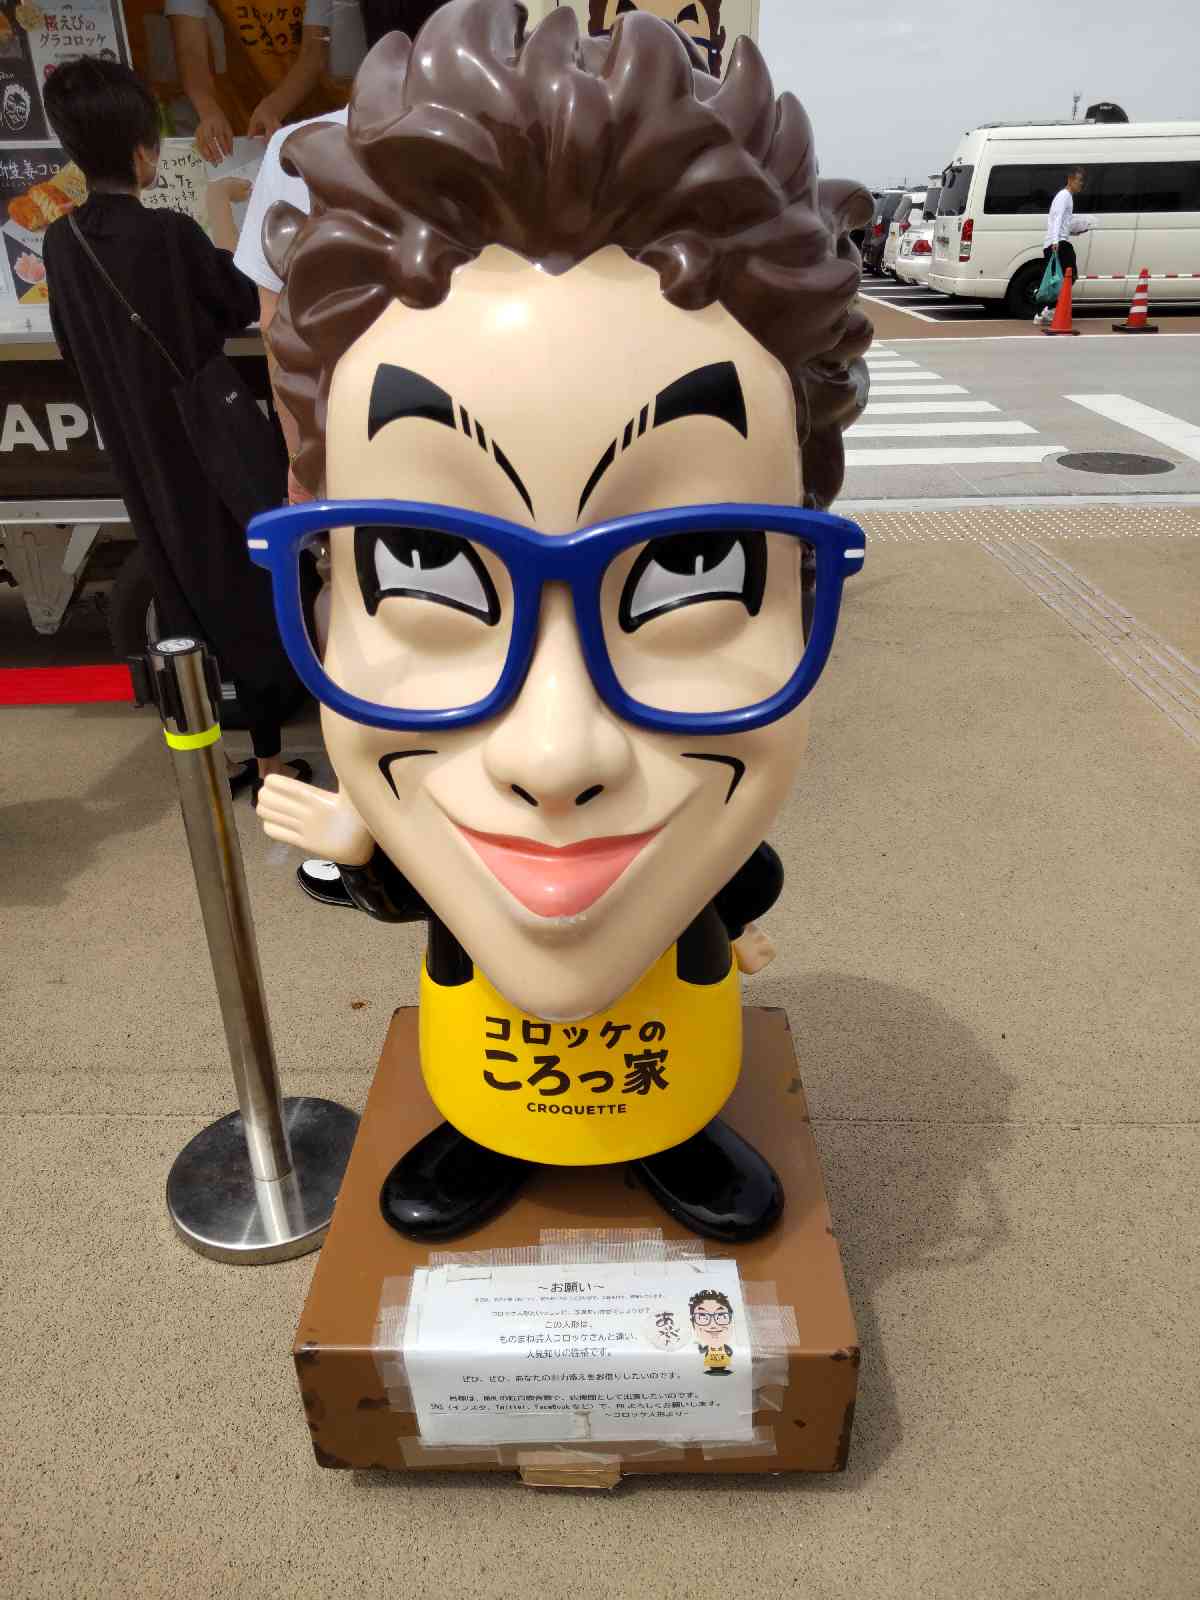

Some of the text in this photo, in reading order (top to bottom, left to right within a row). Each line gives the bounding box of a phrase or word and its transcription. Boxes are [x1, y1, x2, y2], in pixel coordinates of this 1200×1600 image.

[39, 33, 108, 49] グラコロッケ
[0, 402, 105, 452] AP
[484, 1015, 667, 1050] コロッケの
[482, 1048, 670, 1097] ころっ家
[526, 1102, 628, 1116] CROQUETTE
